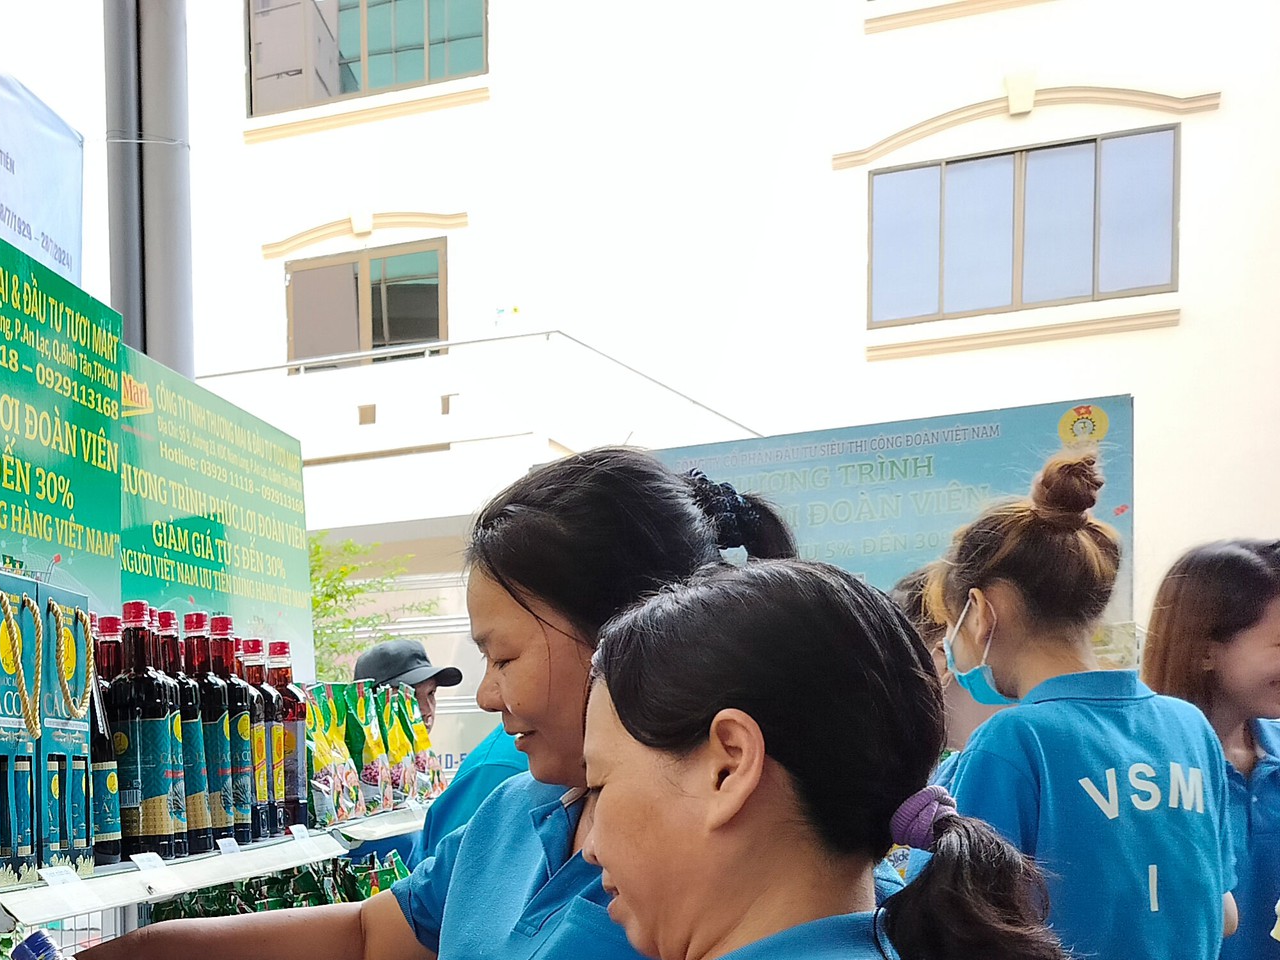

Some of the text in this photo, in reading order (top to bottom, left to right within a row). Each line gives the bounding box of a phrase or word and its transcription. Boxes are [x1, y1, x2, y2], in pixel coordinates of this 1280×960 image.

[11, 274, 20, 311] &
[23, 272, 46, 324] ĐẦU
[48, 297, 64, 333] TƯ
[65, 307, 91, 351] TƯƠI
[92, 323, 119, 365] MART
[35, 363, 119, 421] 0929113168
[25, 403, 77, 458] ĐOÀN
[80, 426, 119, 475] VIÊN
[160, 441, 199, 471] Hotline:
[819, 424, 1000, 458] SIÊU THỊ CÔNG ĐOÀN VIỆT NAM
[35, 468, 74, 510] 30%
[838, 455, 934, 484] TRÌNH
[169, 478, 207, 519] TRÌNH
[807, 490, 902, 527] ĐOÀN
[11, 503, 53, 543] HÀNG
[53, 515, 85, 548] VIỆT
[152, 514, 233, 566] GIẢM GIÁ TỪ
[177, 561, 199, 587] NAM
[1148, 864, 1159, 912] I
